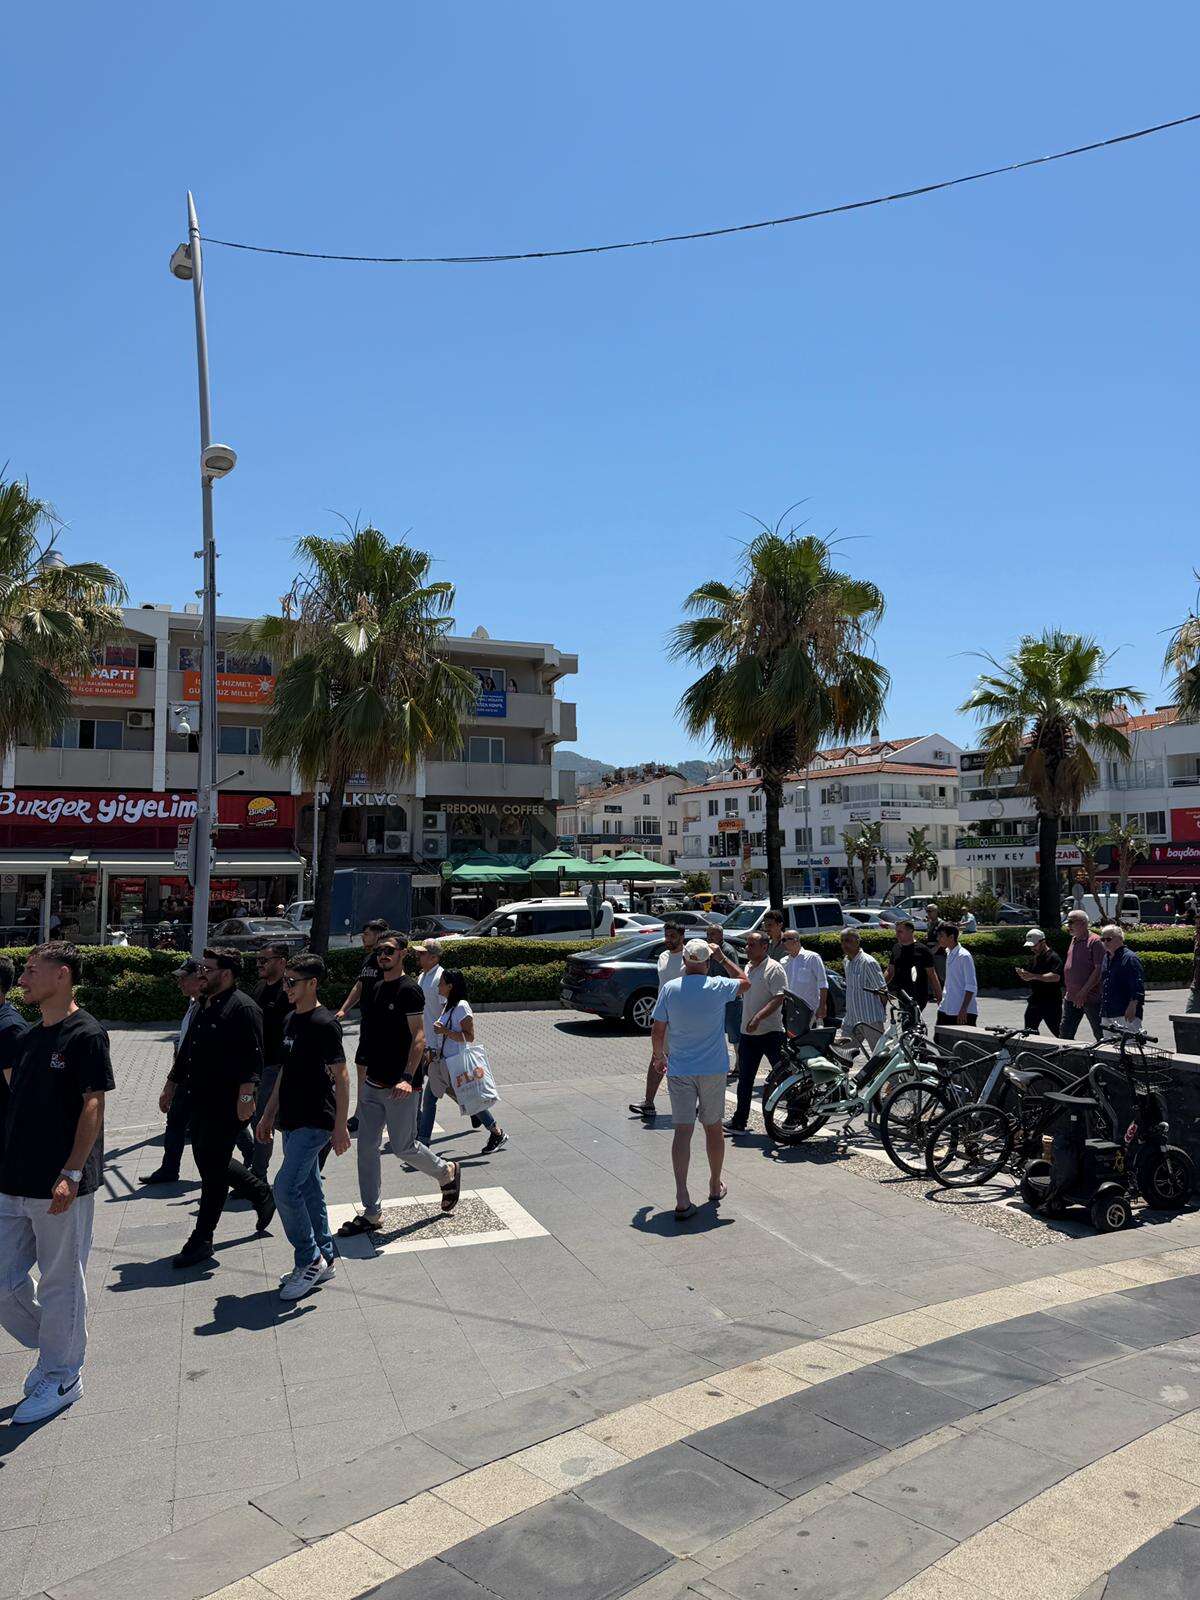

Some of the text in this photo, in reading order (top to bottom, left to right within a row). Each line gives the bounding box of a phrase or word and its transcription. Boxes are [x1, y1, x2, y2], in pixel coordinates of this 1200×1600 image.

[440, 803, 544, 815] FREDONIA COFFEE
[966, 852, 1024, 861] JIMMY KEY
[455, 1066, 485, 1088] FLO
